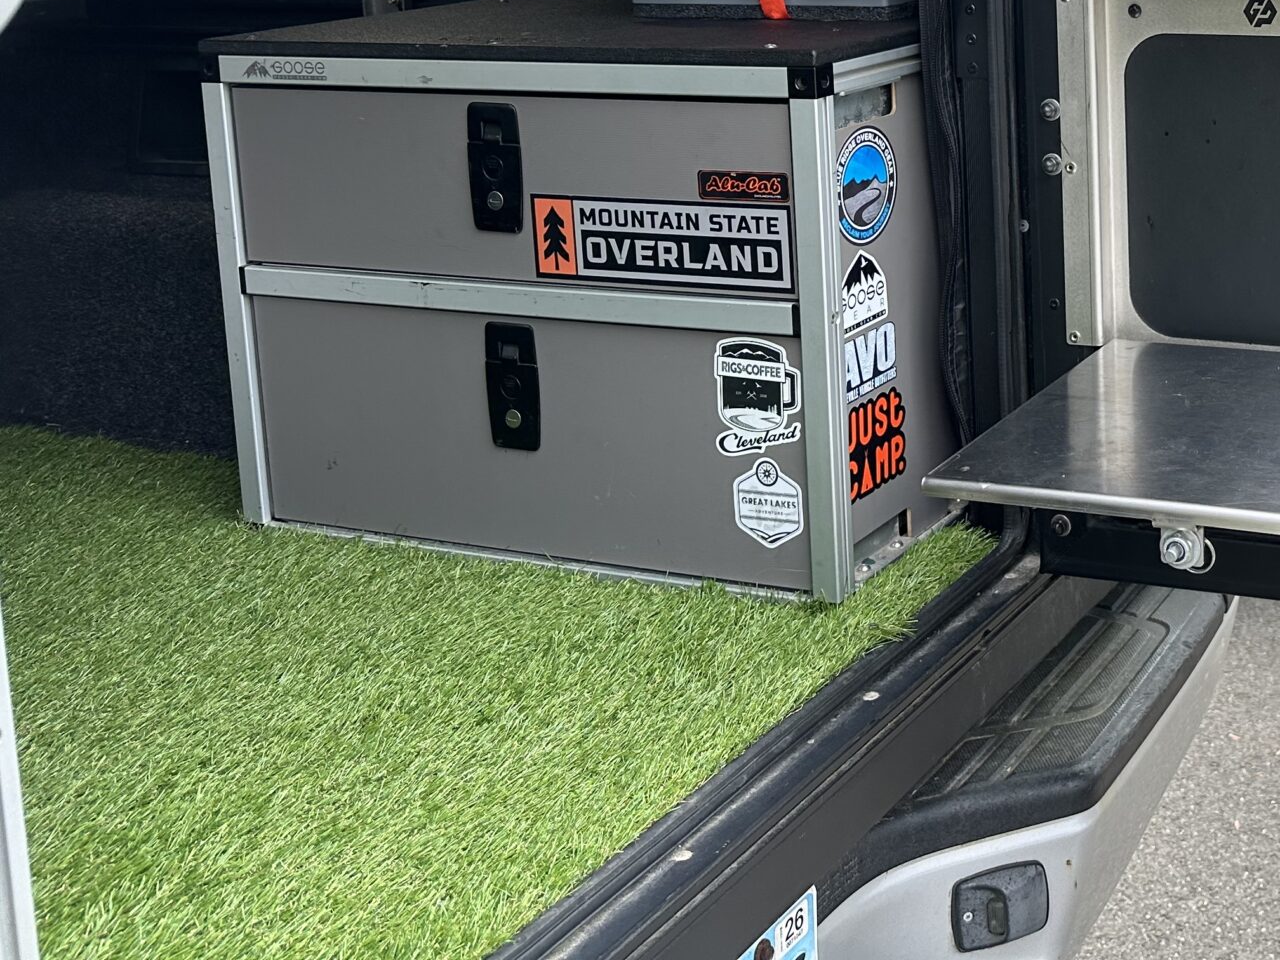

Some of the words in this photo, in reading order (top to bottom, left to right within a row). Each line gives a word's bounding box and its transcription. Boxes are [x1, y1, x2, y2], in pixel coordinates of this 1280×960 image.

[841, 138, 856, 165] RIDGE
[855, 132, 886, 150] OVERLAND
[883, 148, 895, 175] GEAR
[706, 175, 782, 195] Alu-Cab
[579, 207, 701, 231] MOUNTAIN
[709, 213, 781, 235] STATE
[860, 228, 874, 239] YOUR
[873, 201, 892, 233] JOURNEY
[585, 236, 780, 274] OVERLAND
[719, 425, 798, 453] Cleveland
[741, 496, 769, 506] GREAT
[770, 499, 797, 509] LAKES
[785, 906, 805, 942] 26
